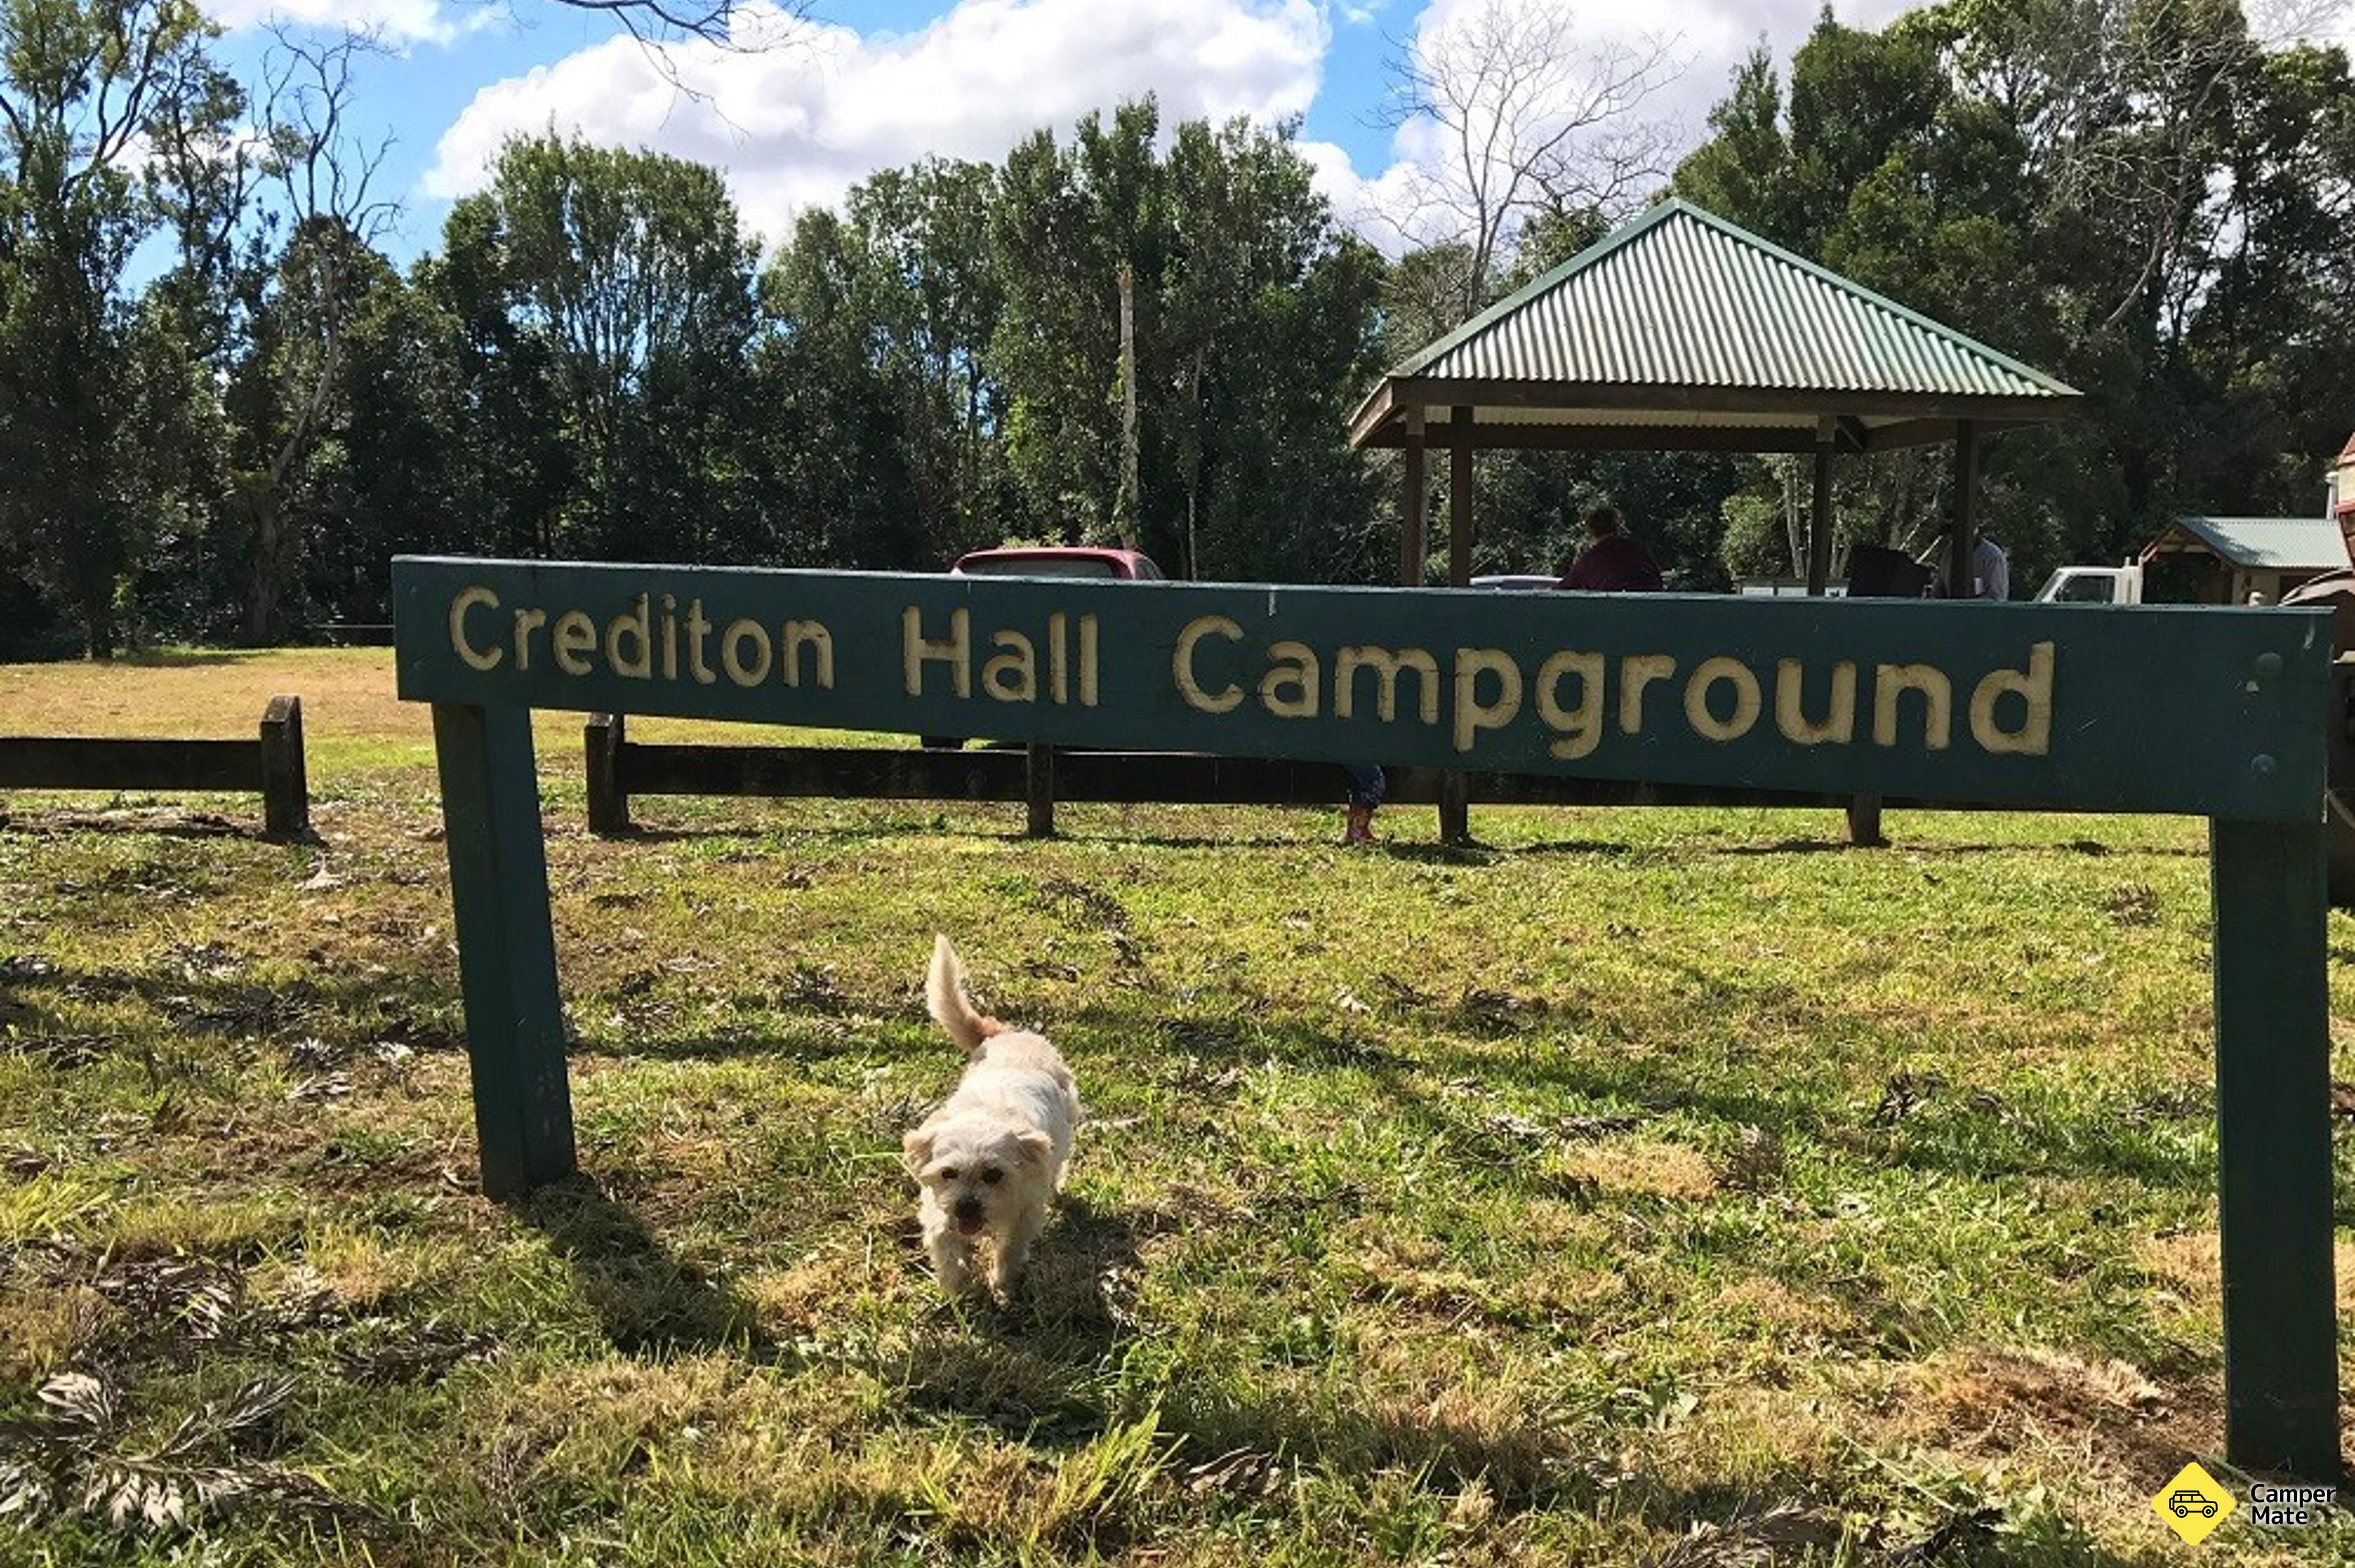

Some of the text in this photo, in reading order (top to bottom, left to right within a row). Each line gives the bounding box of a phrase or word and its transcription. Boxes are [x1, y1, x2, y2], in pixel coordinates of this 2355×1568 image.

[450, 587, 2055, 759] Crediton Hall Campground
